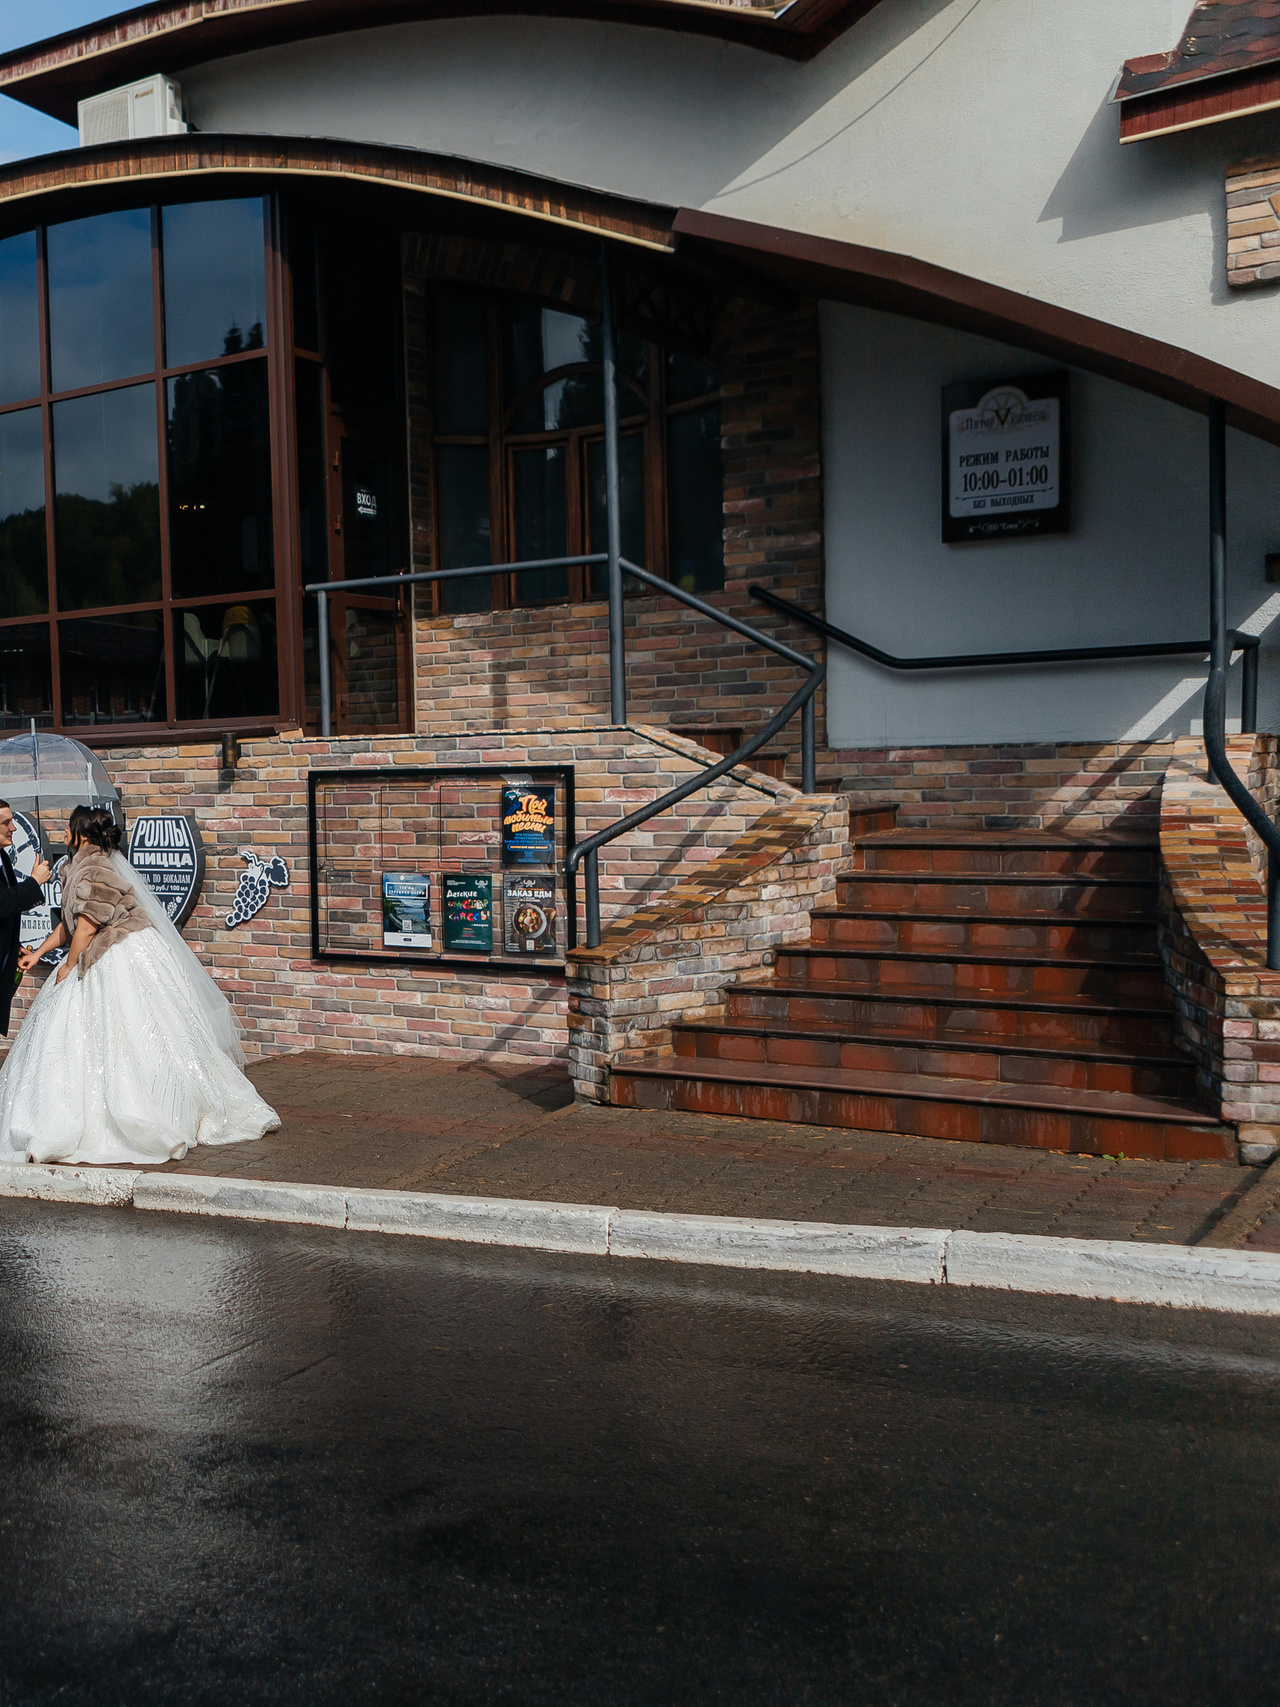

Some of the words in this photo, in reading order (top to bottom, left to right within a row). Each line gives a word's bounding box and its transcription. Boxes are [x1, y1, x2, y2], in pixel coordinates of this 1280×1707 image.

[959, 451, 999, 468] РЕЖИМ
[1005, 446, 1050, 462] РАБОТЫ
[962, 464, 1049, 493] 10:00-01:00
[973, 499, 987, 509] БЕЗ
[990, 494, 1035, 508] ВЫХОДНЫХ
[134, 820, 189, 847] РОЛЛЫ
[133, 852, 193, 868] ПИЦЦА
[152, 873, 161, 883] ПО
[162, 874, 191, 884] БОКАЛАМ
[446, 889, 478, 898] Детские
[507, 889, 533, 897] ЗАКАЗ
[534, 890, 552, 898] ЕДЫ
[21, 919, 50, 930] МПЛЕКС
